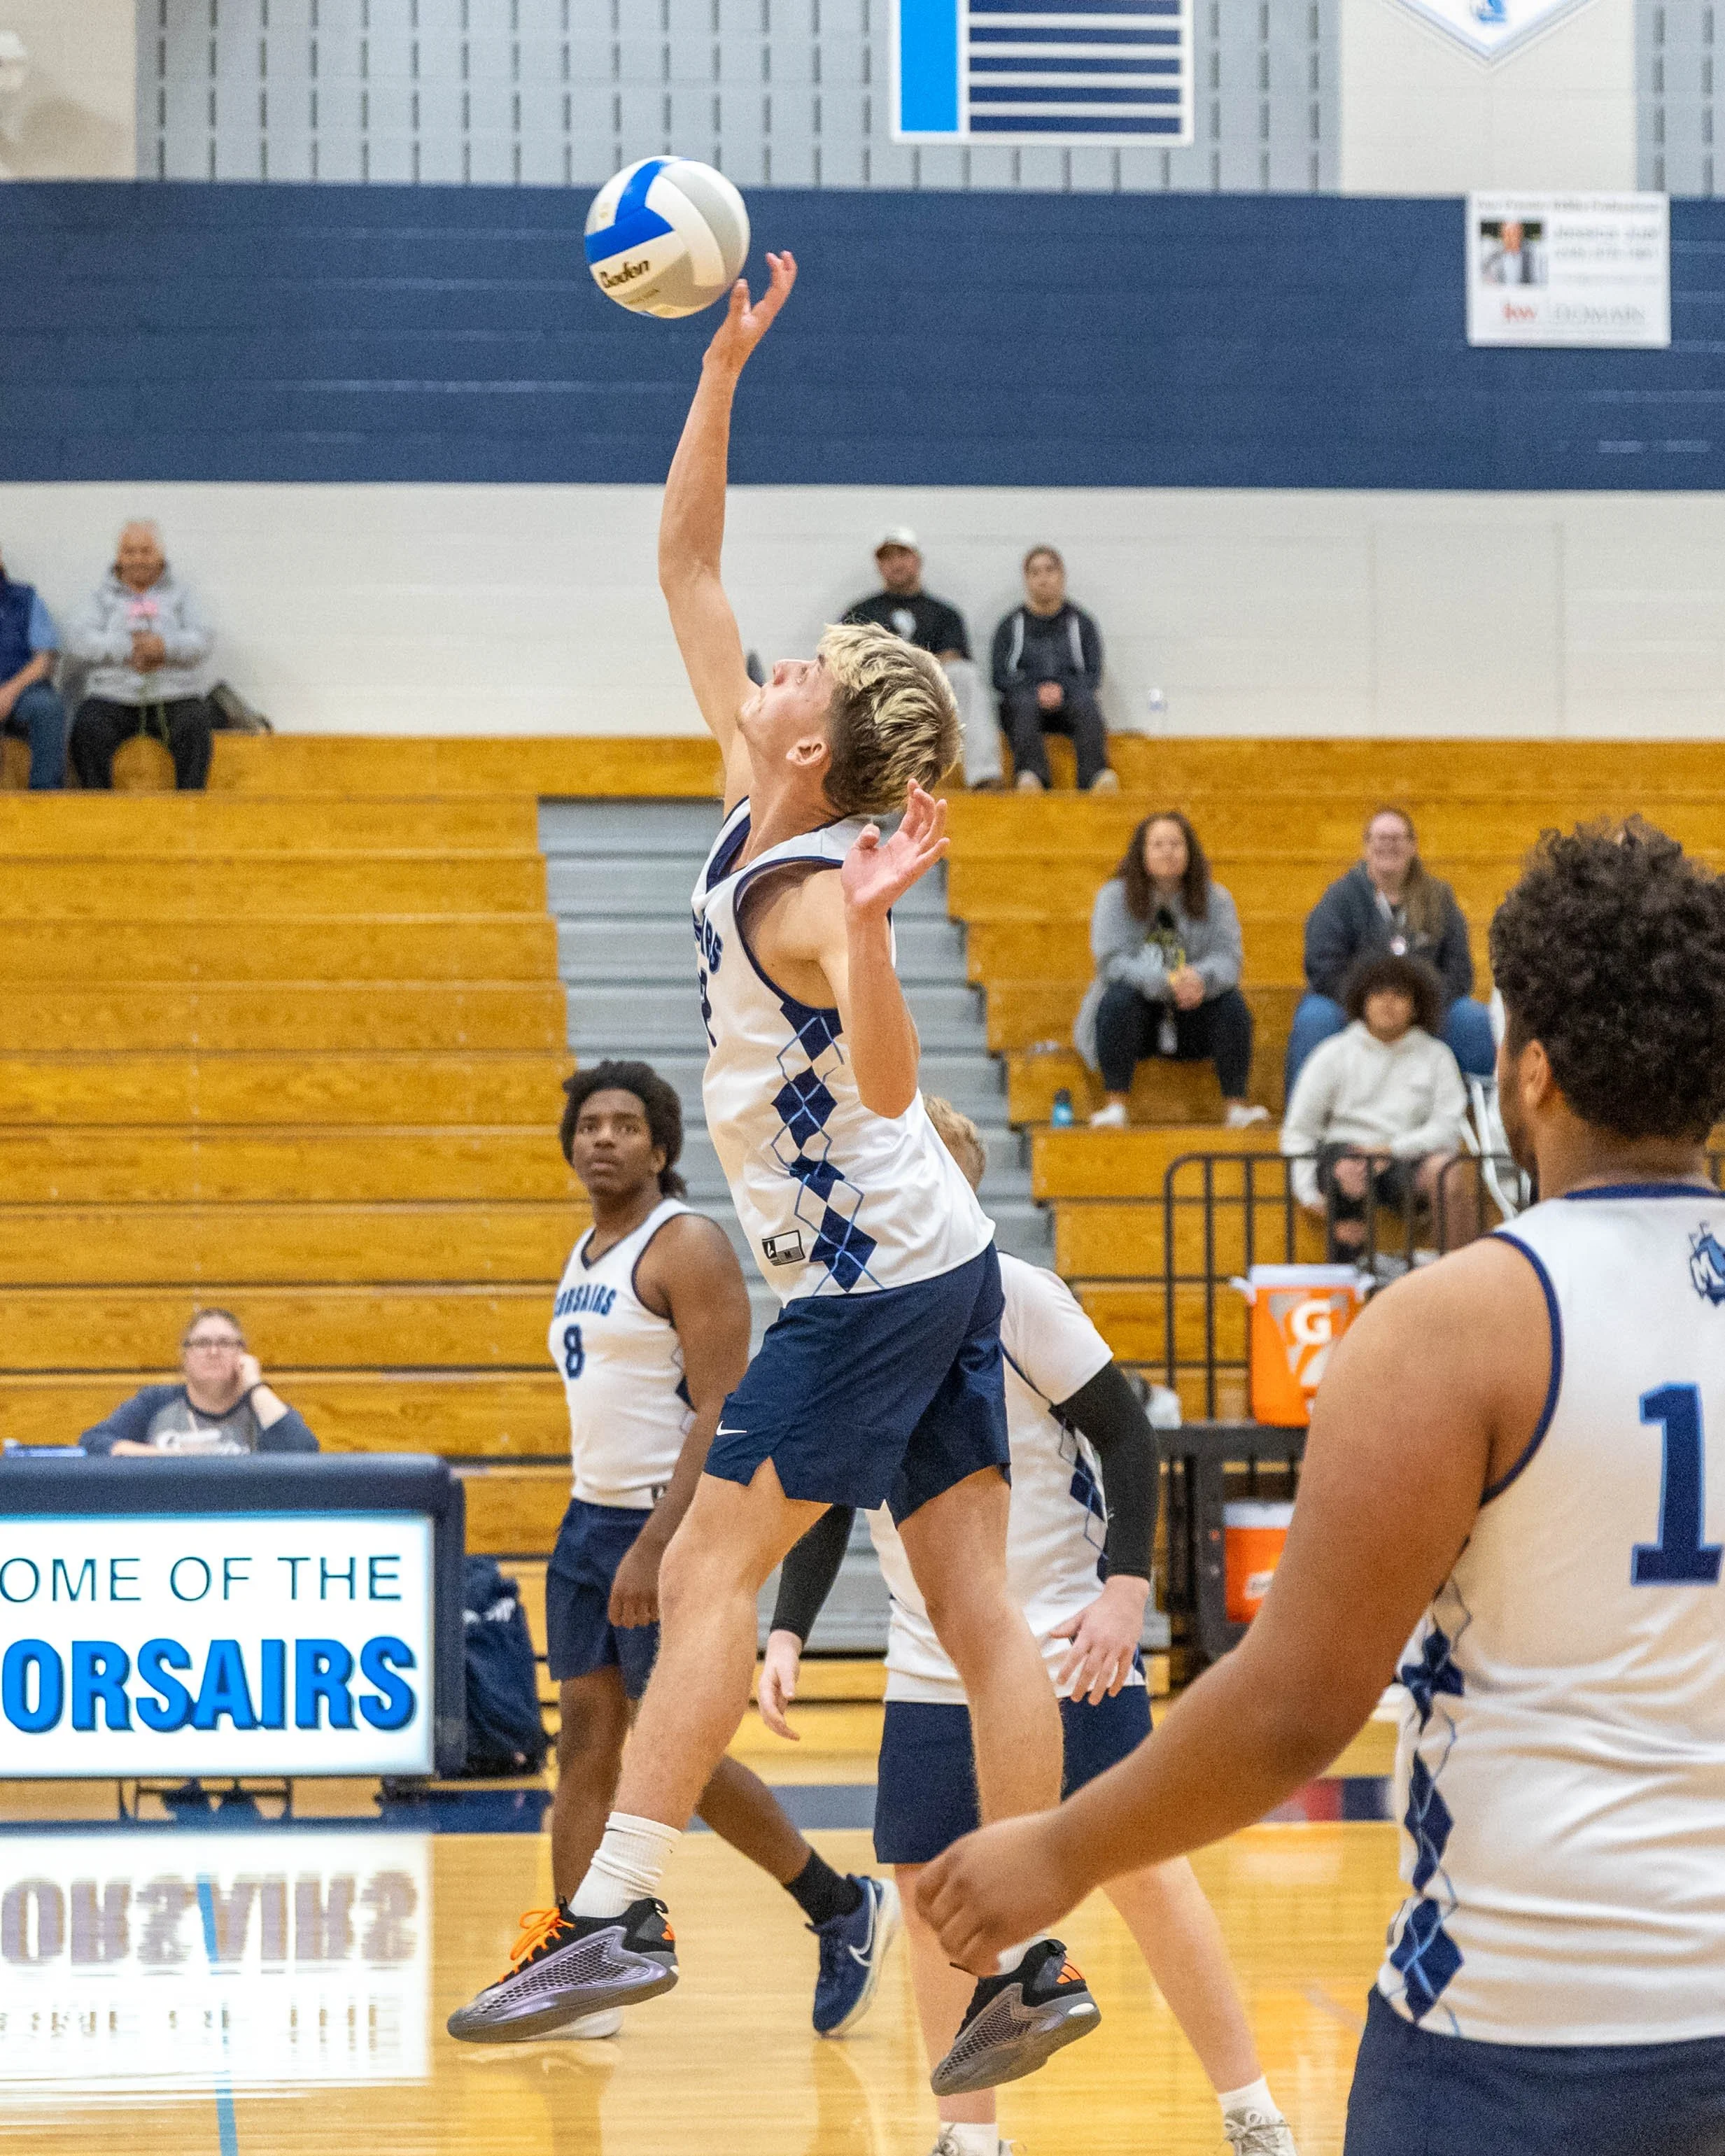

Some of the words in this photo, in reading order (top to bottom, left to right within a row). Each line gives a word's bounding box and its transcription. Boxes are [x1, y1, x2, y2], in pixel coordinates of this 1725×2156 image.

[564, 1324, 584, 1379] 8
[1631, 1381, 1723, 1586] 1
[0, 1557, 141, 1602] OME
[170, 1556, 252, 1601] OF
[278, 1555, 402, 1601] THE
[1, 1635, 416, 1733] ORSAIRS
